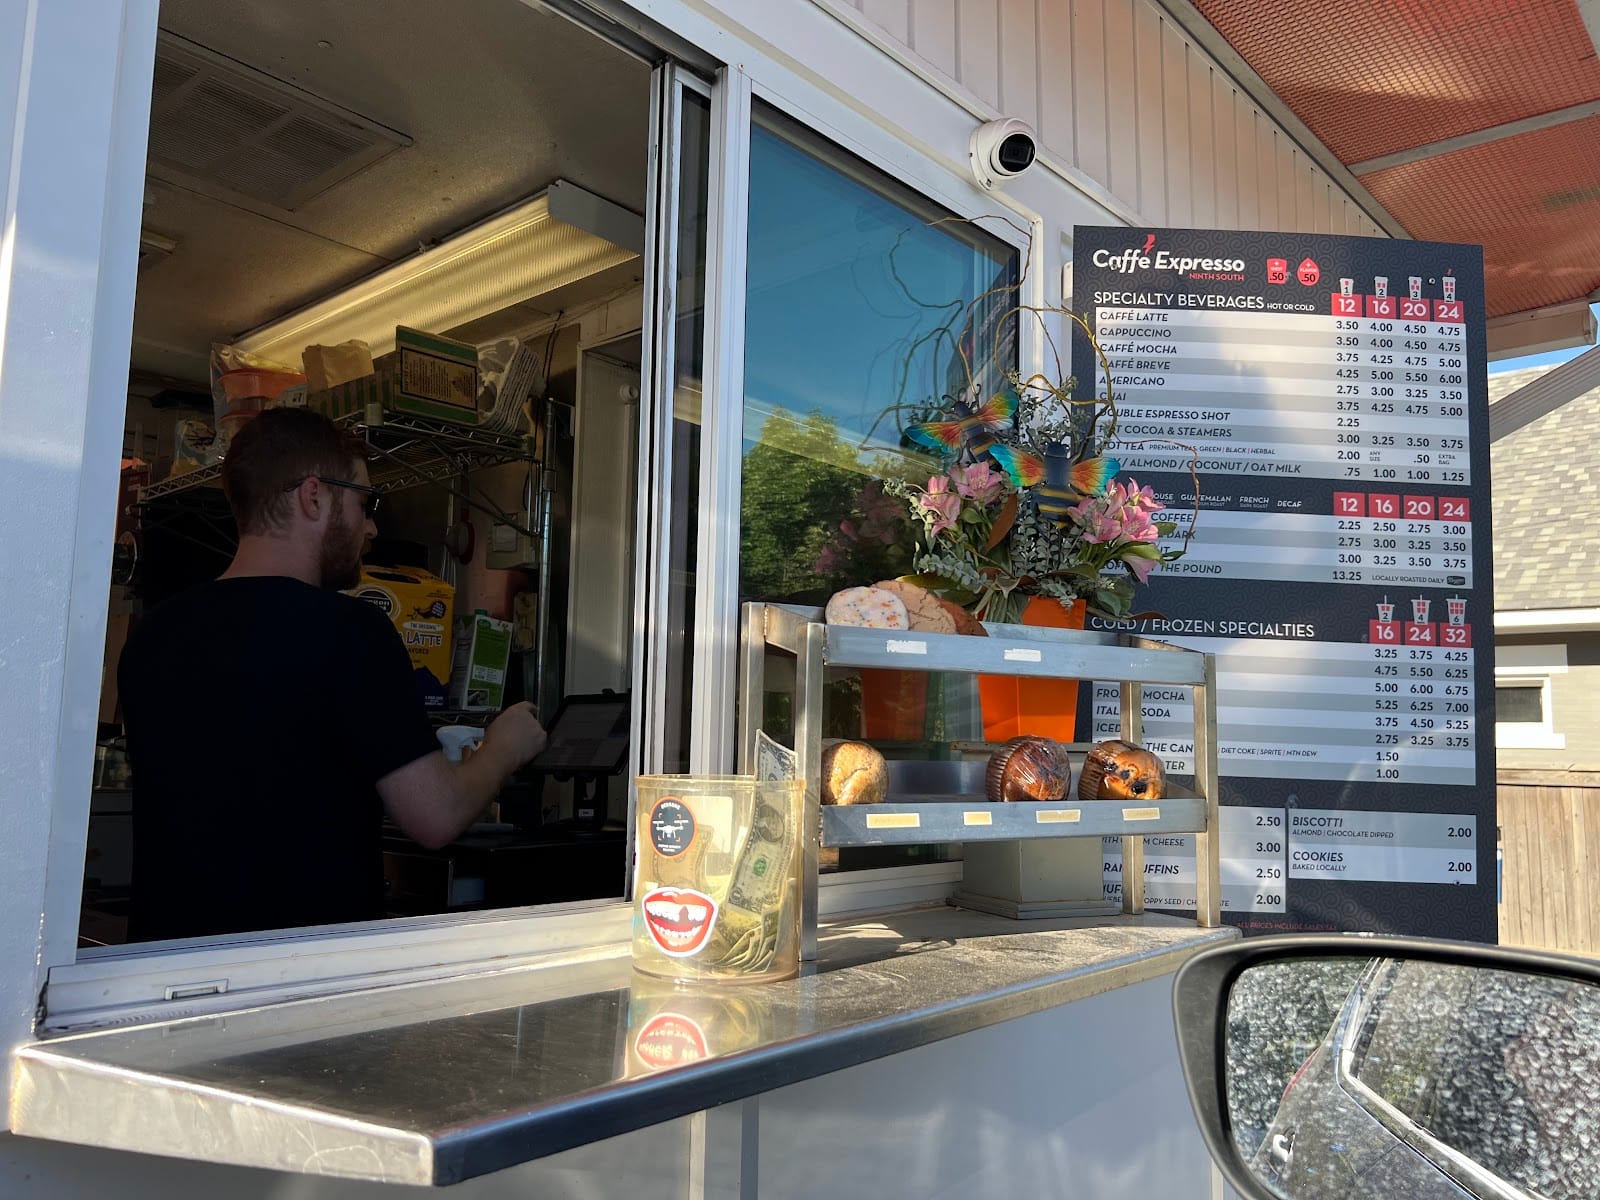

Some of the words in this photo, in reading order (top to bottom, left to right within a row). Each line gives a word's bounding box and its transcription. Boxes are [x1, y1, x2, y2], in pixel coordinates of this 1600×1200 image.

[1155, 251, 1245, 274] Expresso
[1302, 274, 1316, 282] .50
[1094, 292, 1174, 306] SPECIALTY
[1180, 293, 1264, 309] BEVERAGES
[1267, 302, 1283, 310] HOT
[1338, 299, 1356, 313] 12
[1373, 301, 1390, 314] 16
[1404, 303, 1427, 316] 20
[1438, 305, 1459, 319] 24
[1100, 311, 1134, 321] CAFFÉ
[1137, 313, 1168, 322] LATTE
[1336, 321, 1359, 330] 3.50
[1370, 322, 1393, 332] 4.00
[1405, 324, 1427, 334] 4.50
[1438, 326, 1460, 336] 4.75
[1100, 328, 1171, 337] CAPPUCCINO
[1336, 337, 1359, 346] 3.50
[1370, 338, 1393, 348] 4.00
[1405, 341, 1427, 350] 4.50
[1438, 343, 1461, 352] 4.75
[1100, 342, 1134, 353] CAFFÉ
[1137, 344, 1177, 354] MOCHA
[1336, 353, 1359, 362] 3.75
[1371, 355, 1393, 364] 4.25
[1405, 357, 1427, 366] 4.75
[1439, 359, 1461, 368] 5.00
[1100, 358, 1134, 369] CAFFÉ
[1137, 361, 1170, 370] BREVE
[1336, 369, 1359, 379] 4.25
[1371, 371, 1393, 381] 5.00
[1405, 373, 1428, 382] 5.50
[1440, 375, 1461, 384] 6.00
[1337, 385, 1359, 395] 2.75
[1371, 387, 1394, 396] 3.00
[1406, 389, 1428, 398] 3.25
[1440, 391, 1462, 400] 3.50
[1337, 401, 1359, 411] 3.75
[1371, 403, 1394, 413] 4.25
[1405, 405, 1428, 415] 4.75
[1440, 407, 1462, 416] 5.00
[1145, 410, 1199, 420] ESPRESSO
[1201, 412, 1231, 421] SHOT
[1337, 418, 1360, 427] 2.25
[1124, 425, 1164, 435] COCOA
[1168, 427, 1175, 436] &
[1178, 427, 1232, 437] STEAMERS
[1337, 434, 1360, 443] 3.00
[1372, 436, 1394, 445] 3.25
[1407, 438, 1429, 447] 3.50
[1441, 439, 1463, 449] 3.75
[1337, 451, 1360, 460] 2.00
[1414, 454, 1430, 464] .50
[1129, 458, 1176, 469] ALMOND
[1186, 460, 1242, 472] COCONUT
[1251, 463, 1274, 473] OAT
[1276, 464, 1302, 474] MILK
[1344, 468, 1360, 477] .75
[1373, 469, 1395, 478] 1.00
[1408, 471, 1430, 480] 1.00
[1442, 472, 1464, 482] 1.25
[1240, 496, 1269, 504] FRENCH
[1277, 500, 1302, 508] DECAF
[1341, 498, 1357, 512] 12
[1376, 499, 1393, 513] 16
[1408, 501, 1431, 515] 20
[1444, 503, 1465, 517] 24
[1151, 512, 1193, 522] COFFEE
[1338, 521, 1361, 530] 2.25
[1373, 522, 1396, 532] 2.50
[1408, 524, 1431, 533] 2.75
[1443, 525, 1465, 535] 3.00
[1338, 537, 1361, 547] 2.75
[1373, 539, 1396, 548] 3.00
[1408, 541, 1431, 550] 3.25
[1443, 542, 1466, 552] 3.50
[1339, 554, 1361, 564] 3.00
[1374, 556, 1396, 565] 3.25
[1409, 557, 1431, 567] 3.50
[1444, 559, 1466, 568] 3.75
[1183, 565, 1222, 574] POUND
[1333, 571, 1361, 581] 13.25
[1091, 616, 1136, 630] COLD
[1153, 618, 1215, 633] FROZEN
[1219, 620, 1315, 638] SPECIALTIES
[1376, 626, 1394, 640] 16
[1409, 627, 1431, 641] 24
[1445, 629, 1466, 643] 32
[407, 631, 442, 646] LATTE
[1375, 649, 1397, 659] 3.25
[1410, 650, 1432, 660] 3.75
[1445, 652, 1468, 661] 4.25
[1375, 666, 1398, 675] 4.75
[1410, 667, 1433, 677] 5.50
[1445, 669, 1468, 678] 6.25
[1375, 683, 1398, 692] 5.00
[1410, 685, 1433, 694] 6.00
[1446, 686, 1468, 695] 6.75
[1143, 690, 1185, 700] MOCHA
[1376, 700, 1398, 710] 5.25
[1411, 702, 1433, 711] 6.25
[1446, 703, 1469, 712] 7.00
[1141, 707, 1170, 717] SODA
[1376, 717, 1398, 727] 3.75
[1411, 719, 1434, 728] 4.50
[1446, 720, 1468, 729] 5.25
[1096, 723, 1120, 733] ICED
[1376, 735, 1398, 744] 2.75
[1411, 736, 1434, 745] 3.25
[1446, 738, 1469, 747] 3.75
[1146, 743, 1167, 752] THE
[1170, 744, 1193, 752] CAN
[1376, 752, 1399, 761] 1.50
[1376, 769, 1399, 779] 1.00
[1256, 816, 1281, 826] 2.50
[1292, 817, 1343, 827] BISCOTTI
[1448, 828, 1471, 838] 2.00
[1153, 838, 1184, 846] CHEESE
[1256, 843, 1281, 852] 3.00
[1293, 852, 1343, 861] COOKIES
[1256, 869, 1281, 878] 2.50
[1448, 862, 1472, 872] 2.00
[1256, 895, 1281, 905] 2.00
